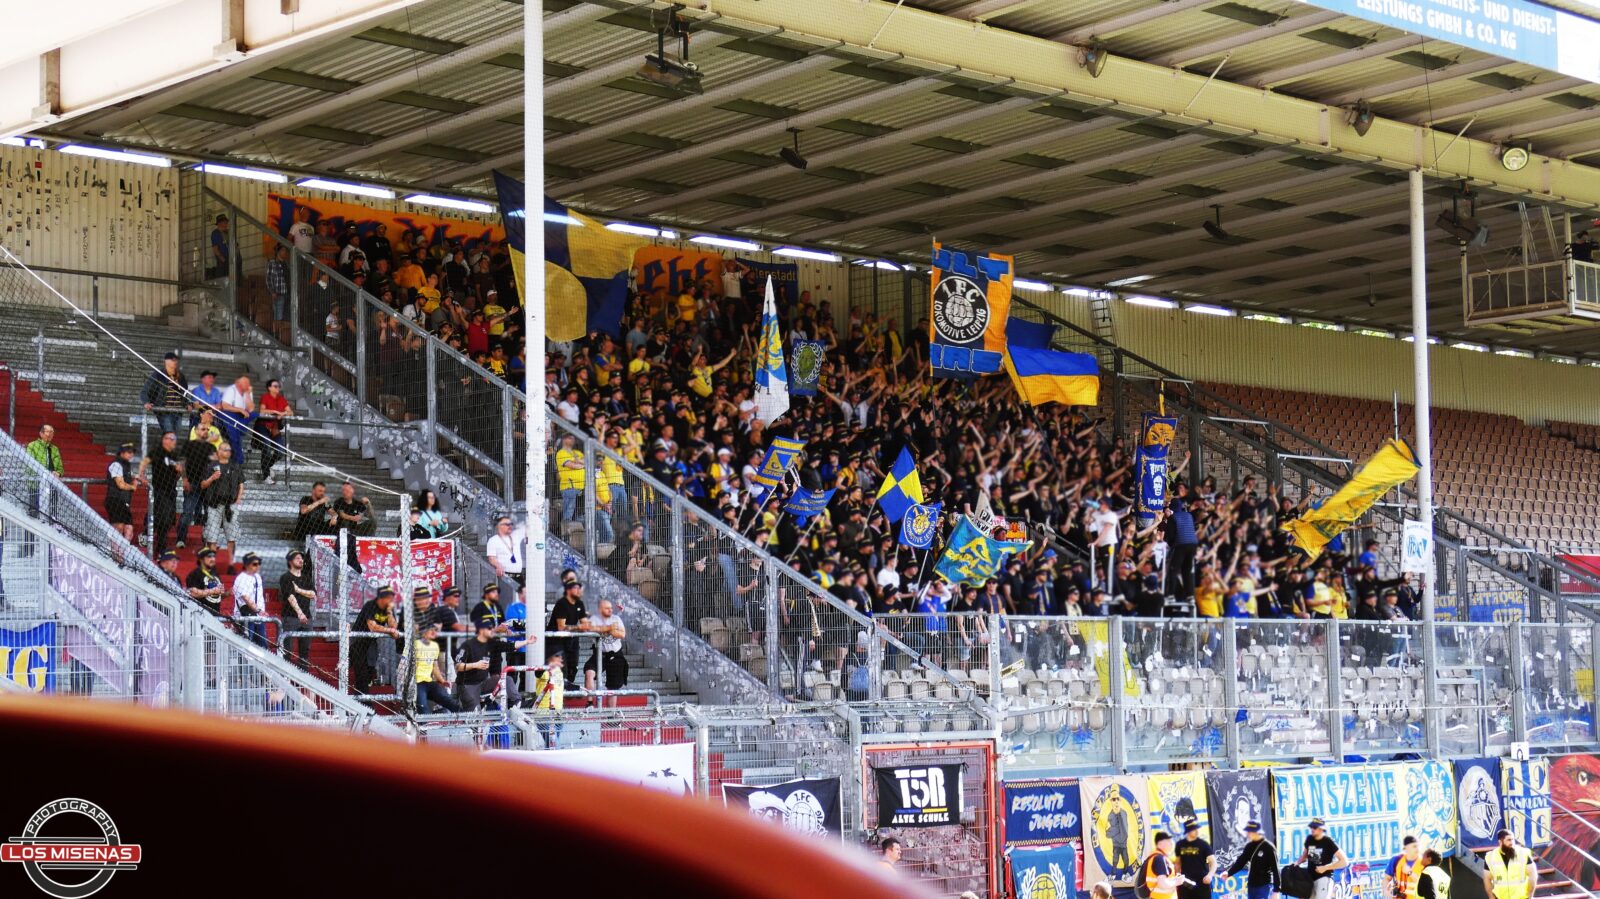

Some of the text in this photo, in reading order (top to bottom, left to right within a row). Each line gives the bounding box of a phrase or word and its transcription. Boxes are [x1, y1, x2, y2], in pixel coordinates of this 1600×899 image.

[1426, 9, 1462, 36] GMBH
[1465, 19, 1474, 39] &
[1477, 22, 1497, 45] CO.
[1500, 29, 1517, 51] KG
[1483, 0, 1509, 23] UND
[1512, 7, 1556, 36] DIENST-
[934, 300, 987, 340] LOKOMOTIVE LEIPZIG
[1275, 771, 1397, 819] FANSZENE
[891, 812, 950, 824] ALTE SCHULE
[1029, 812, 1078, 832] JUGEND
[1279, 821, 1400, 865] LOMOTIVE
